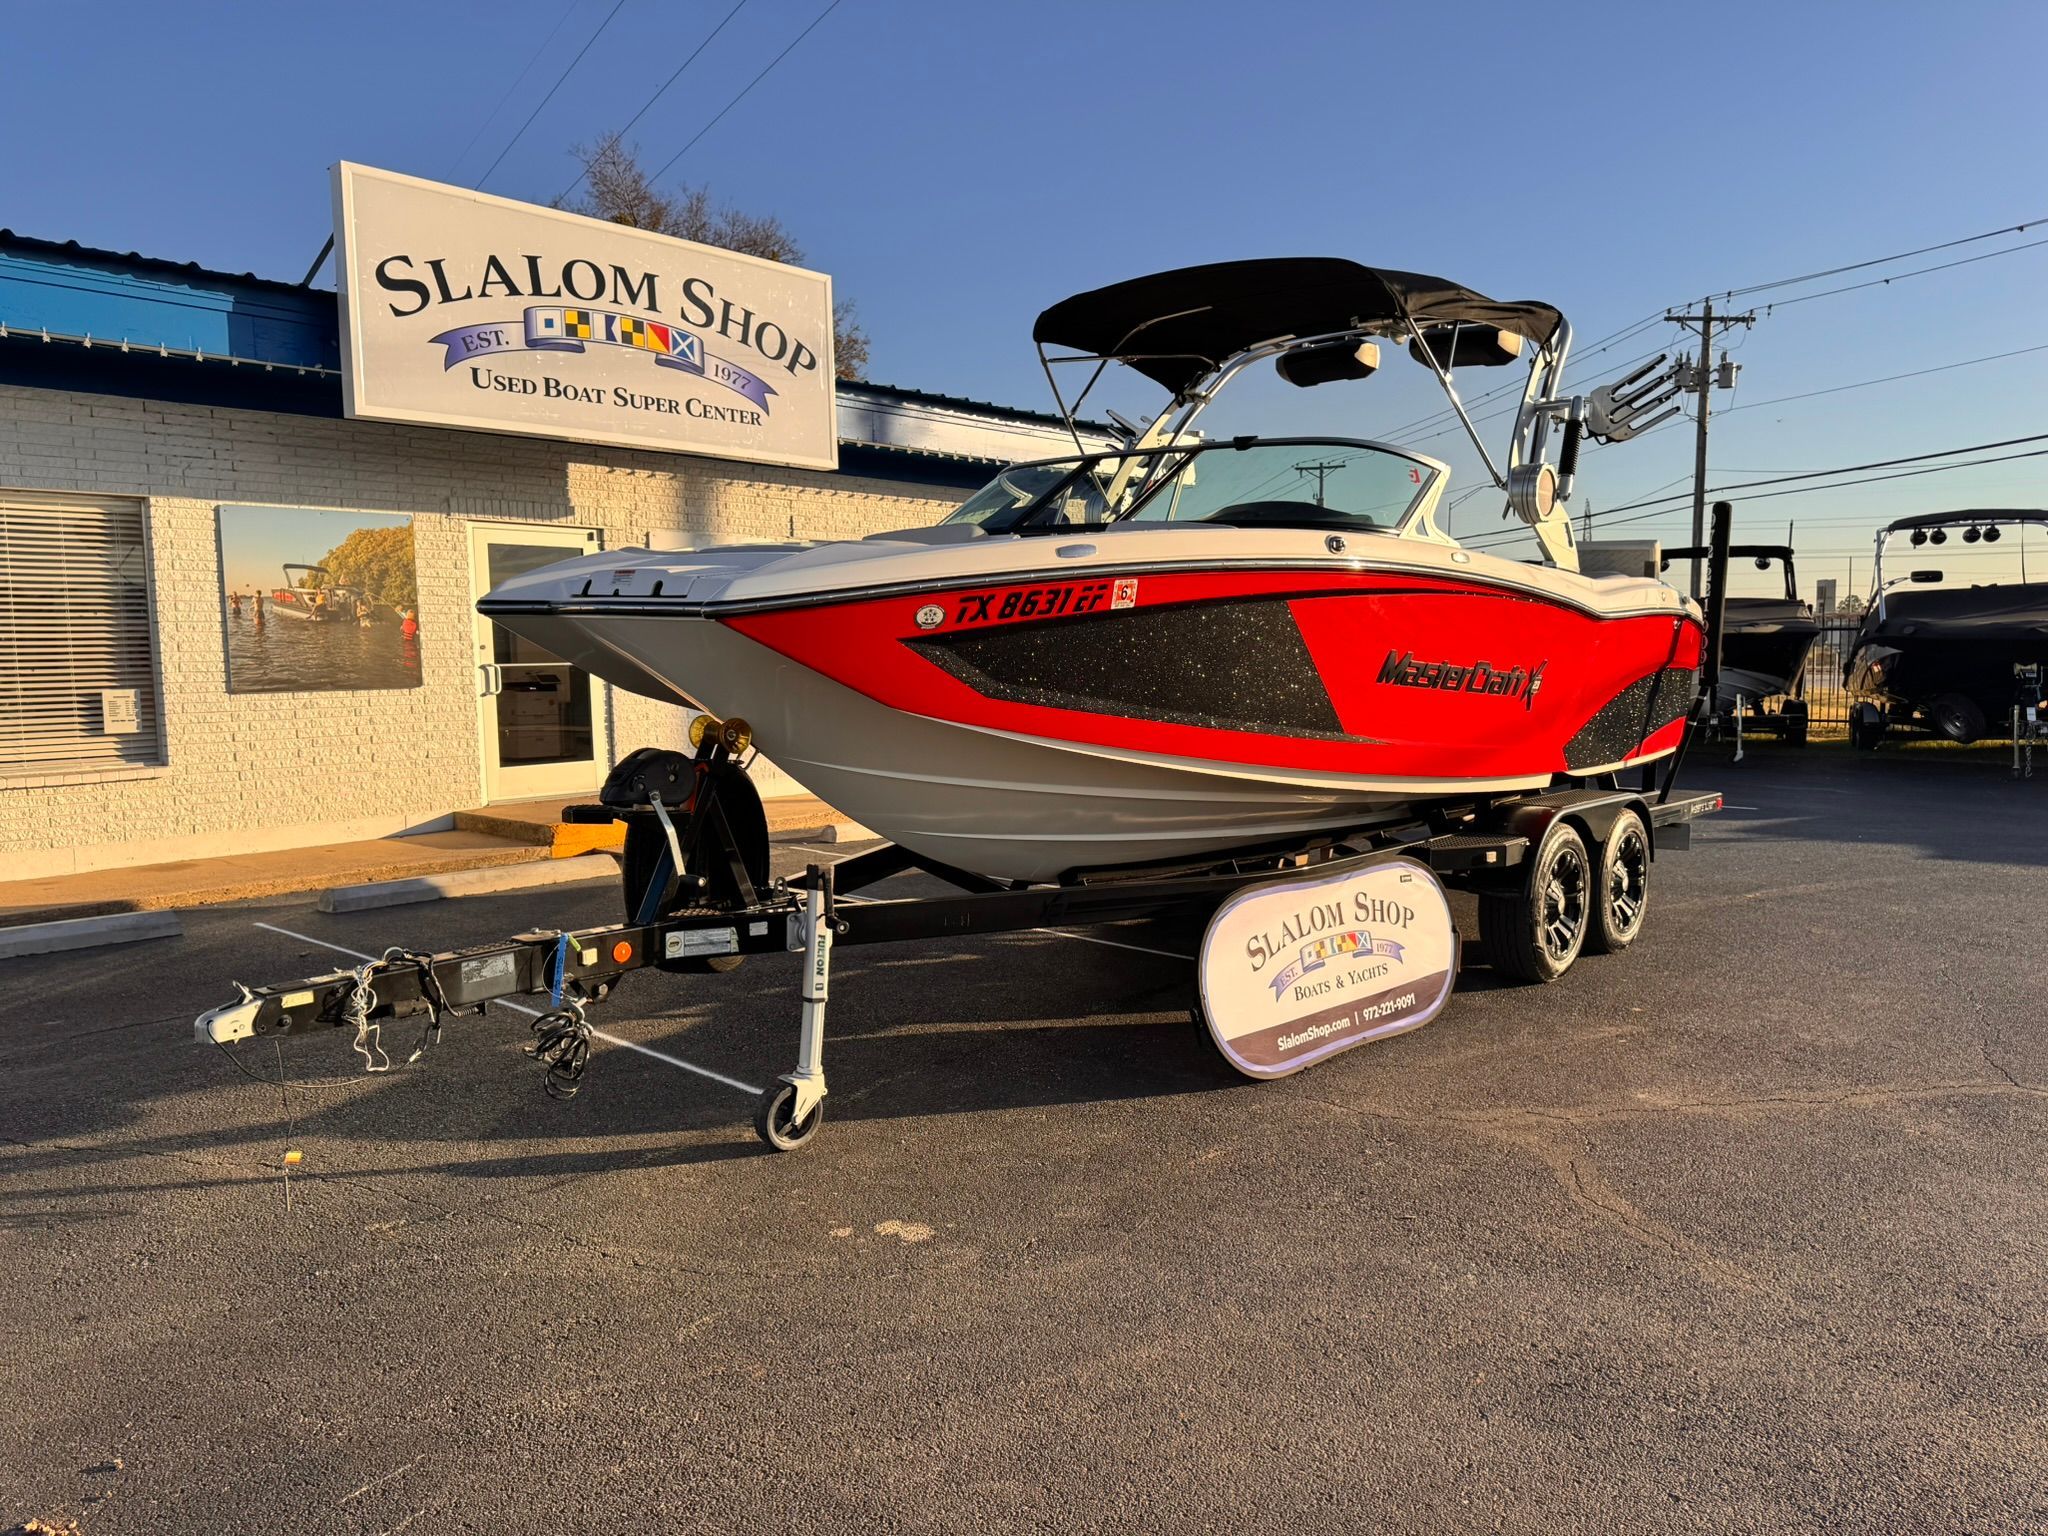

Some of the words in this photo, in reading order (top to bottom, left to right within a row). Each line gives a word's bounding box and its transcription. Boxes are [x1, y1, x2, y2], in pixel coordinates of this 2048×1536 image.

[375, 254, 660, 318] SLALOM
[680, 278, 817, 377] SHOP
[460, 329, 510, 353] EST.
[713, 363, 751, 391] 1977
[470, 367, 537, 395] USED
[543, 376, 607, 405] BOAT
[613, 387, 680, 417] SUPER
[685, 398, 762, 427] CENTER
[955, 594, 996, 624] TX
[997, 587, 1074, 620] 8631
[1120, 584, 1129, 601] 6
[1376, 649, 1527, 697] MasterCraft
[1246, 902, 1345, 972] SLALOM
[1354, 892, 1415, 929] SHOP
[1375, 942, 1394, 954] 1977
[816, 934, 826, 977] FULTON
[1294, 979, 1331, 1002] BOATS
[1335, 974, 1345, 990] &
[1347, 962, 1389, 986] YACHTS
[1277, 1016, 1351, 1052] SlalomShop.com
